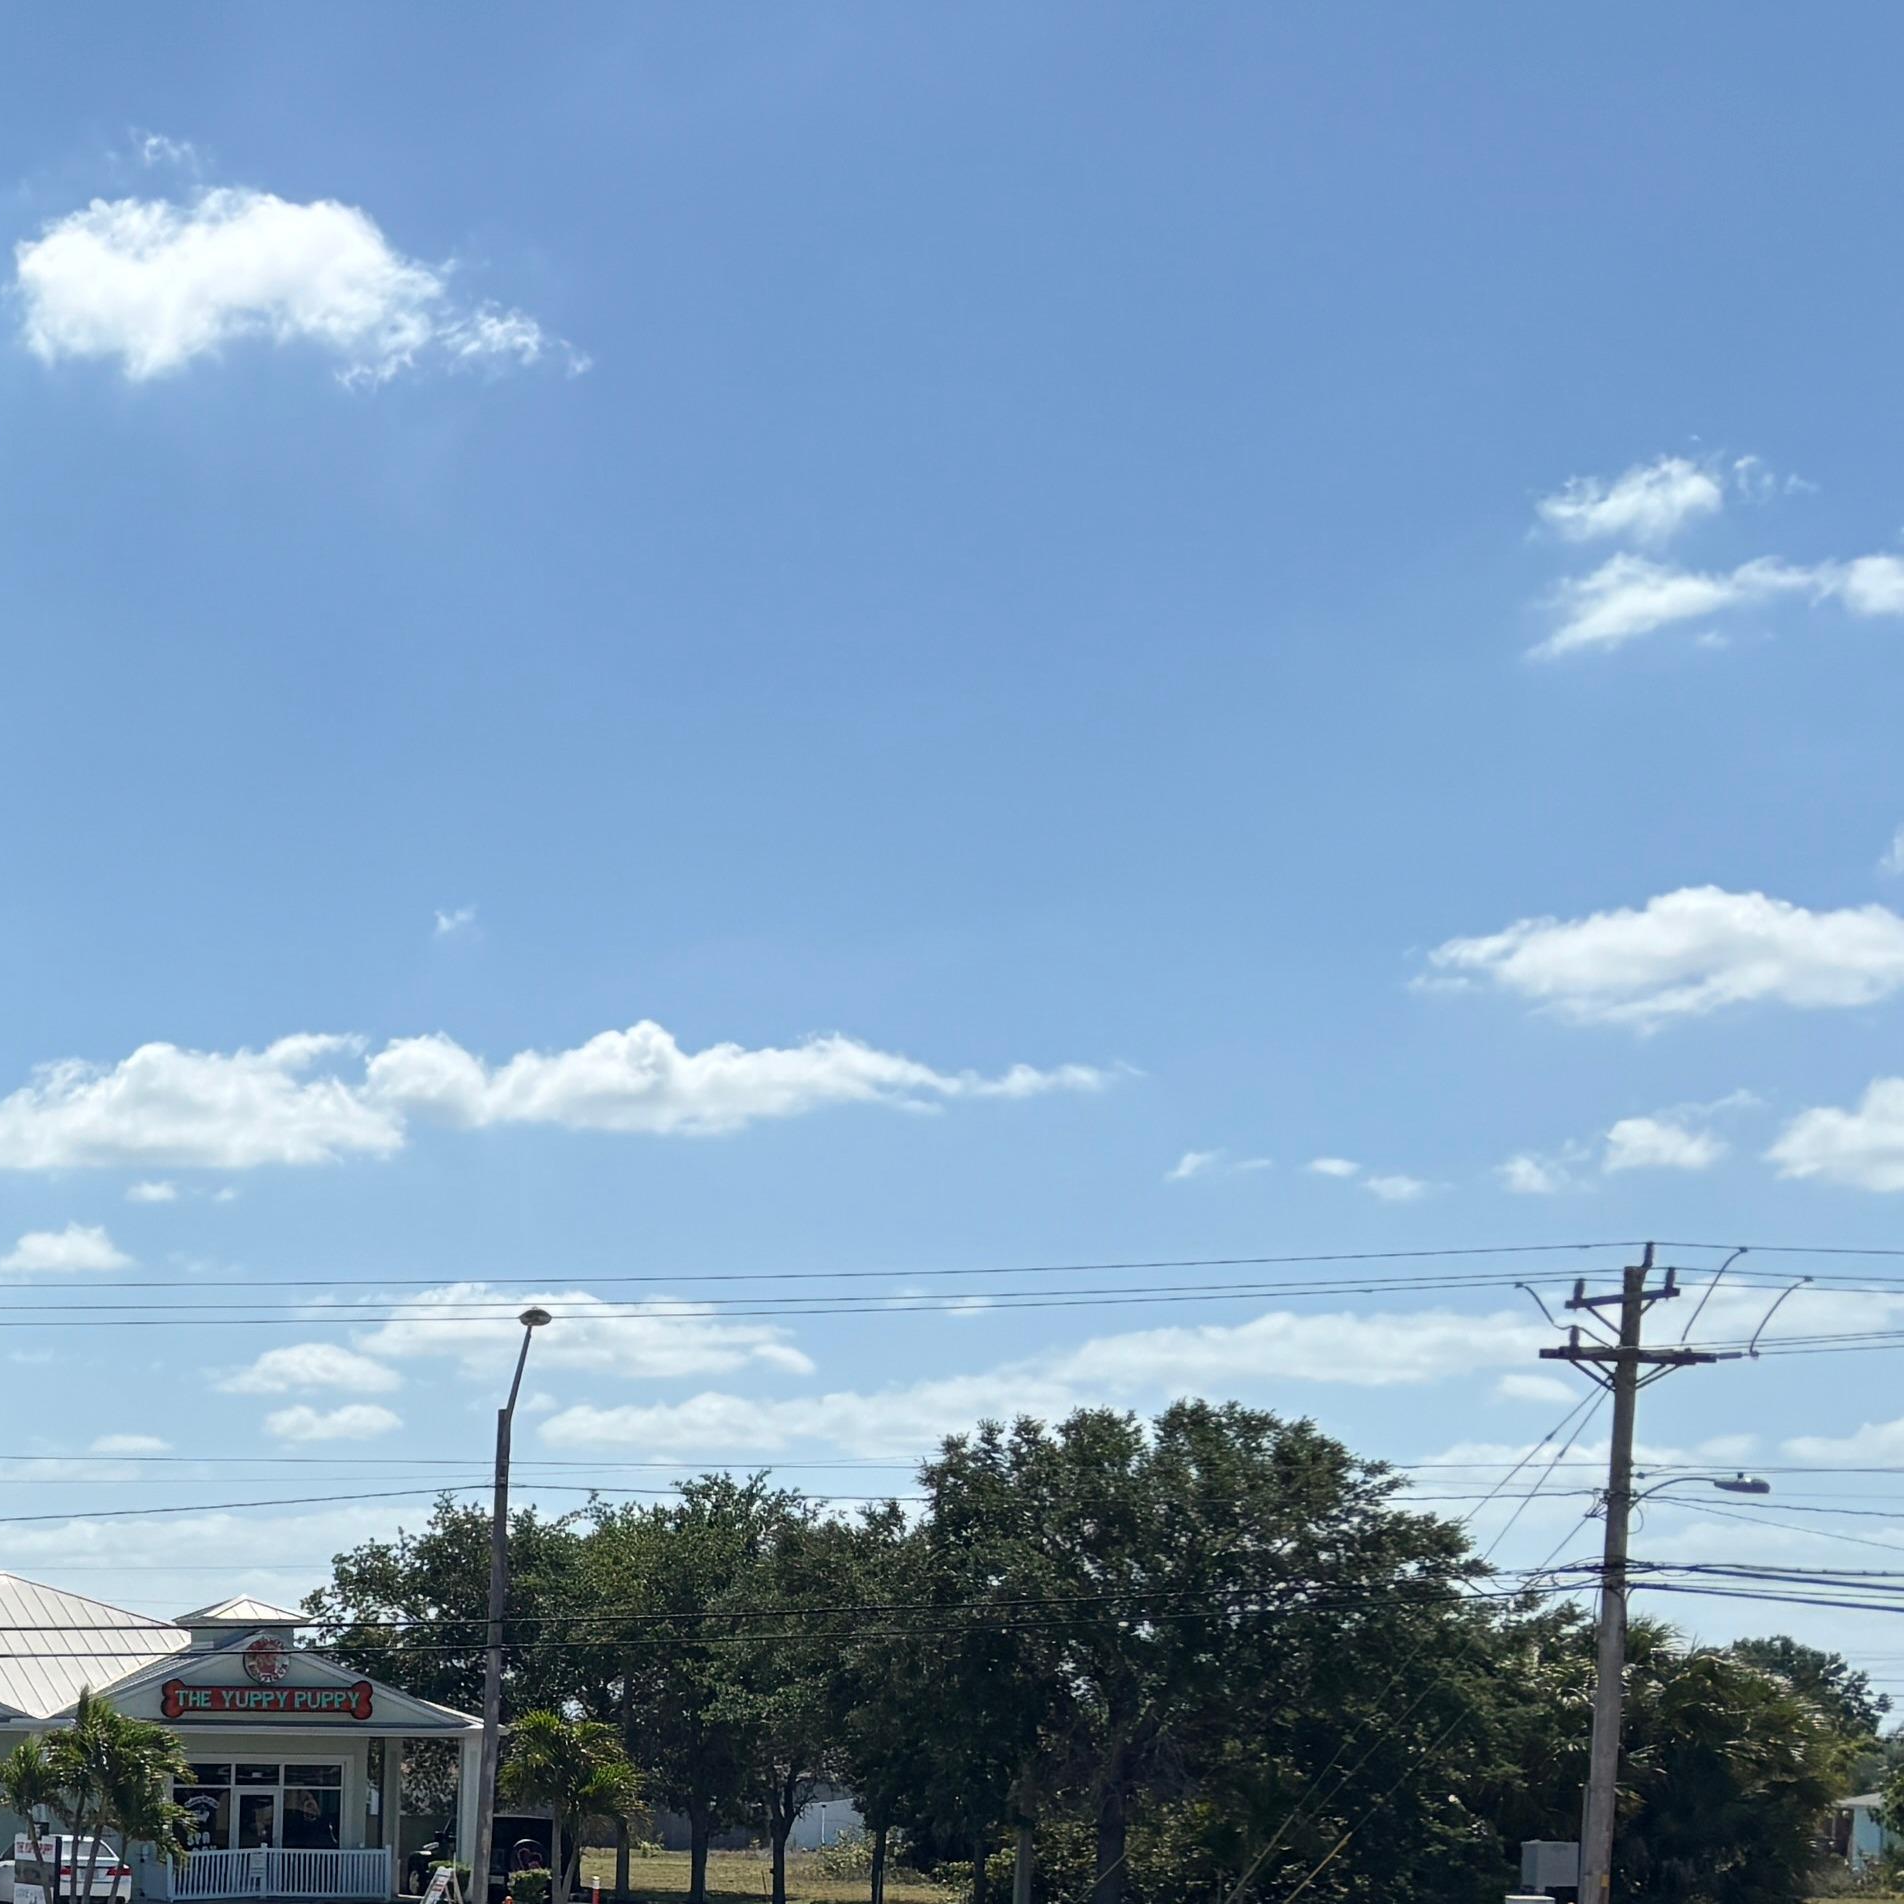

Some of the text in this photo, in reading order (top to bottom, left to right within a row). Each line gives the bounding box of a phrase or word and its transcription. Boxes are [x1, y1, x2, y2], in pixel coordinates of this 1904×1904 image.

[174, 1689, 361, 1709] THE YUPPY PUPPY
